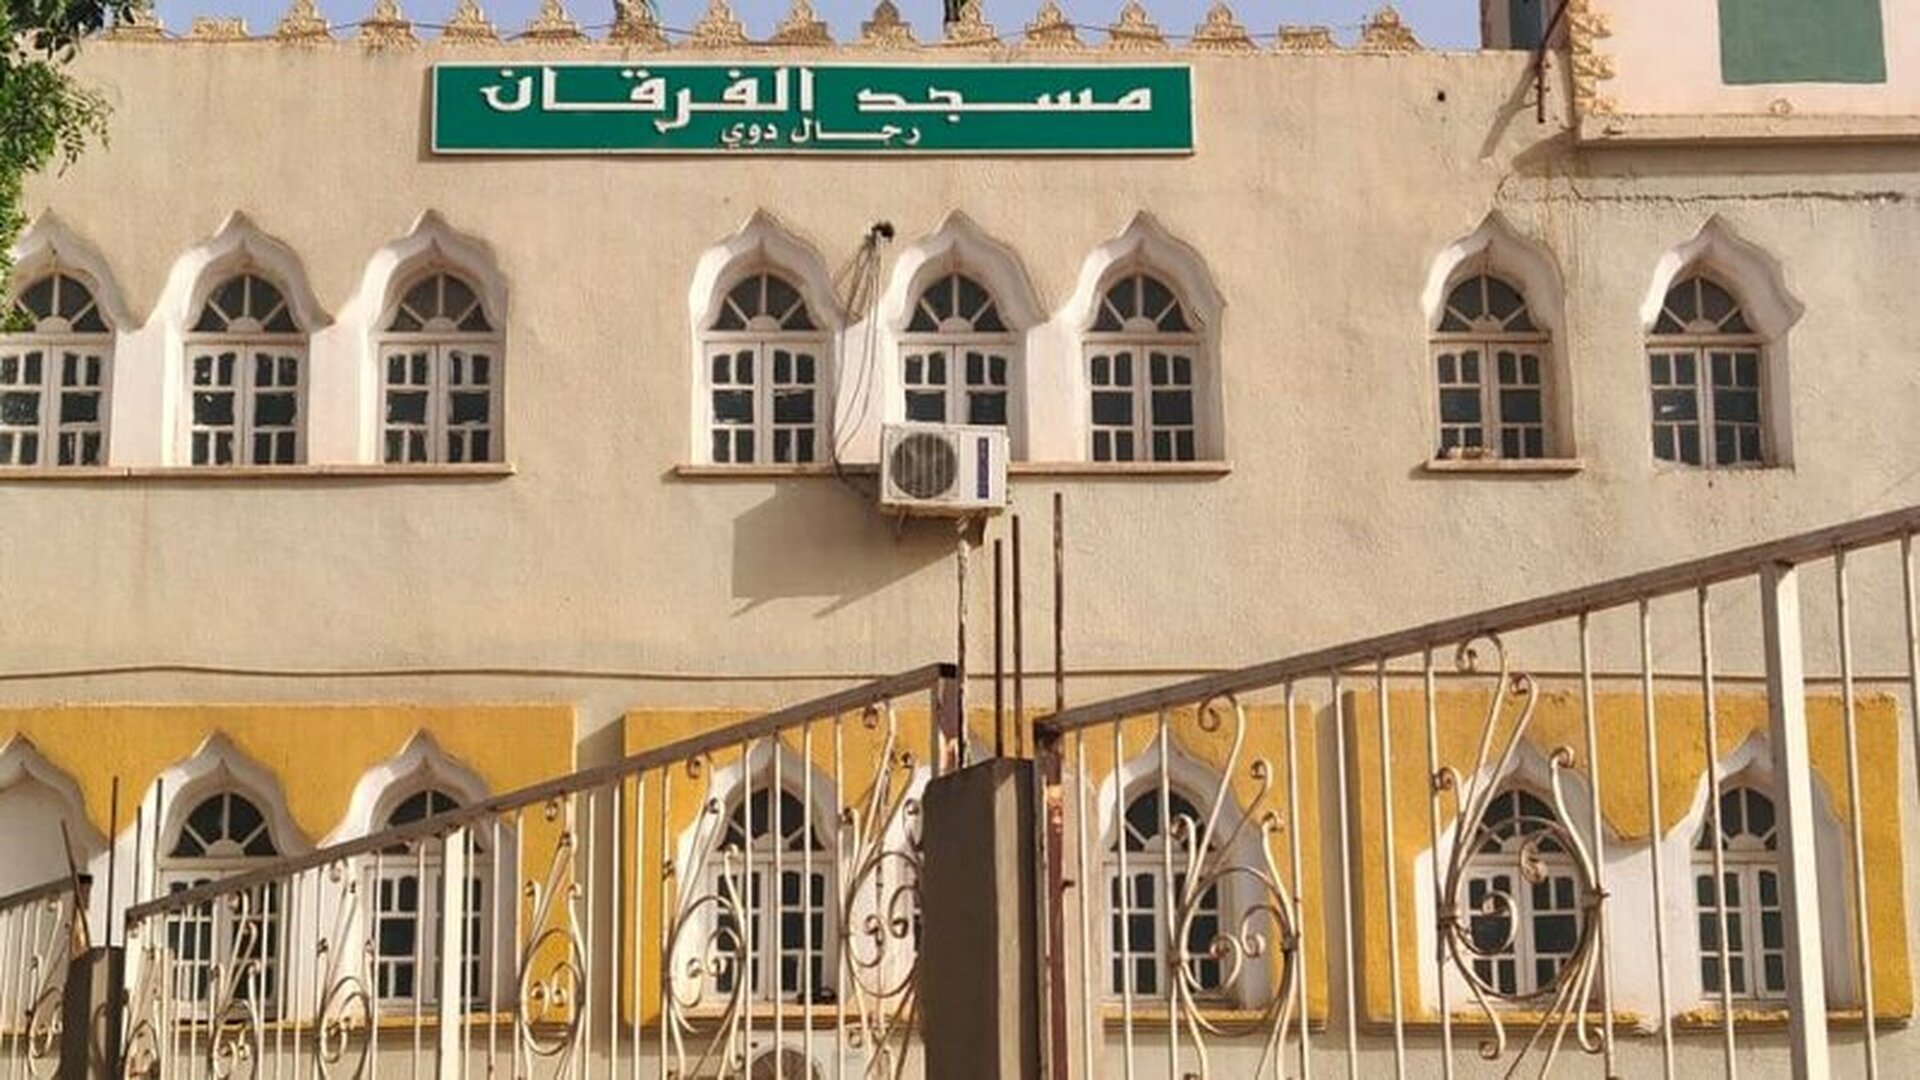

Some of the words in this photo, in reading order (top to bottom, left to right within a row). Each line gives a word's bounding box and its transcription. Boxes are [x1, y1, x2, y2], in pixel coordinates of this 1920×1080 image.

[479, 66, 814, 133] الفرقان
[857, 87, 1151, 122] مسجد
[720, 119, 778, 148] دوي
[790, 118, 920, 146] رجال
